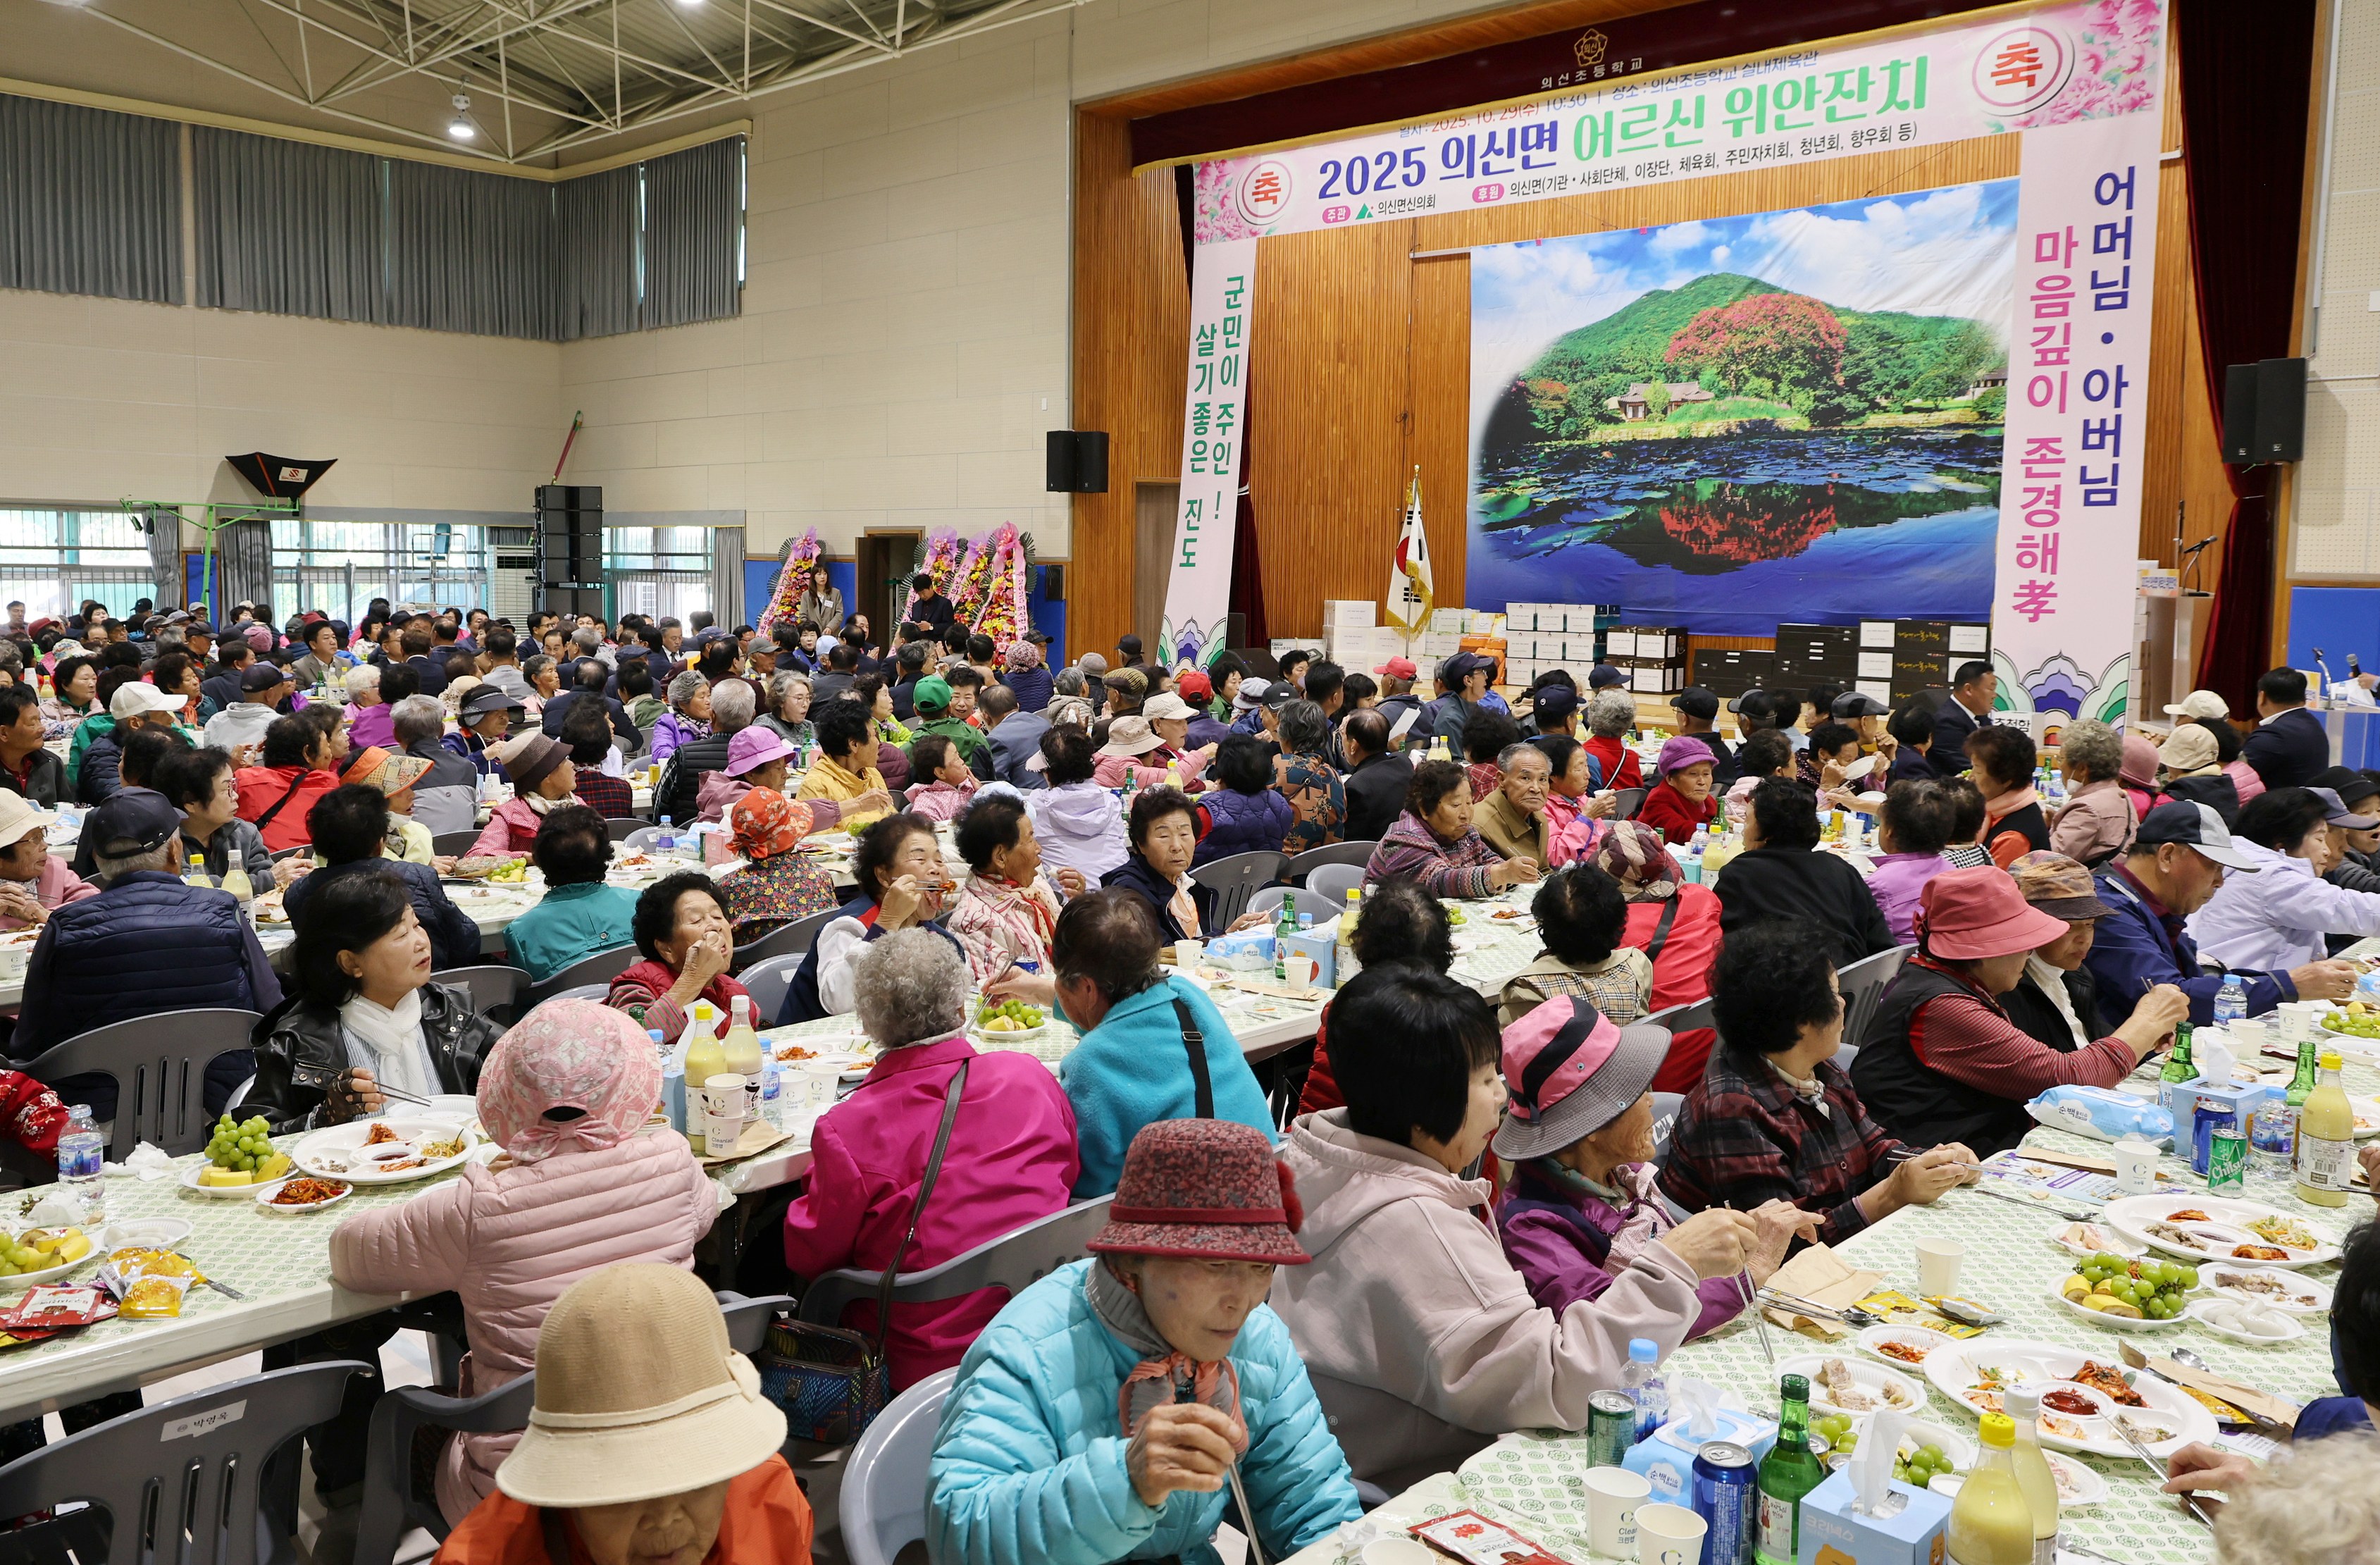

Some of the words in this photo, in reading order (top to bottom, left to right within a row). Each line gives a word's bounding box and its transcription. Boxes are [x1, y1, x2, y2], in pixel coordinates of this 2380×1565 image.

[1541, 57, 1642, 89] 의신초등학교
[1584, 42, 1597, 54] 의신
[1989, 42, 2046, 89] 축
[1318, 146, 1426, 199] 2025
[1439, 120, 1558, 180] 의신면
[1573, 94, 1706, 161] 어르신
[1722, 56, 1929, 138] 위안잔치
[1478, 185, 1499, 202] 후원
[1635, 159, 1673, 179] 이장단,
[1679, 151, 1720, 172] 체육회,
[1725, 141, 1793, 167] 주민자치회,
[1799, 132, 1844, 156] 청년회,
[1851, 125, 1892, 149] 향우회
[1898, 120, 1918, 142] 등)
[1251, 171, 1282, 206] 축
[1327, 207, 1347, 223] 주관
[2090, 165, 2136, 313] 어머님
[1220, 275, 1245, 388] 군민이
[2026, 224, 2079, 415] 마음깊이
[1189, 323, 1217, 474] 살기좋은
[2079, 364, 2129, 508] 아버님
[1179, 498, 1204, 568] 진도
